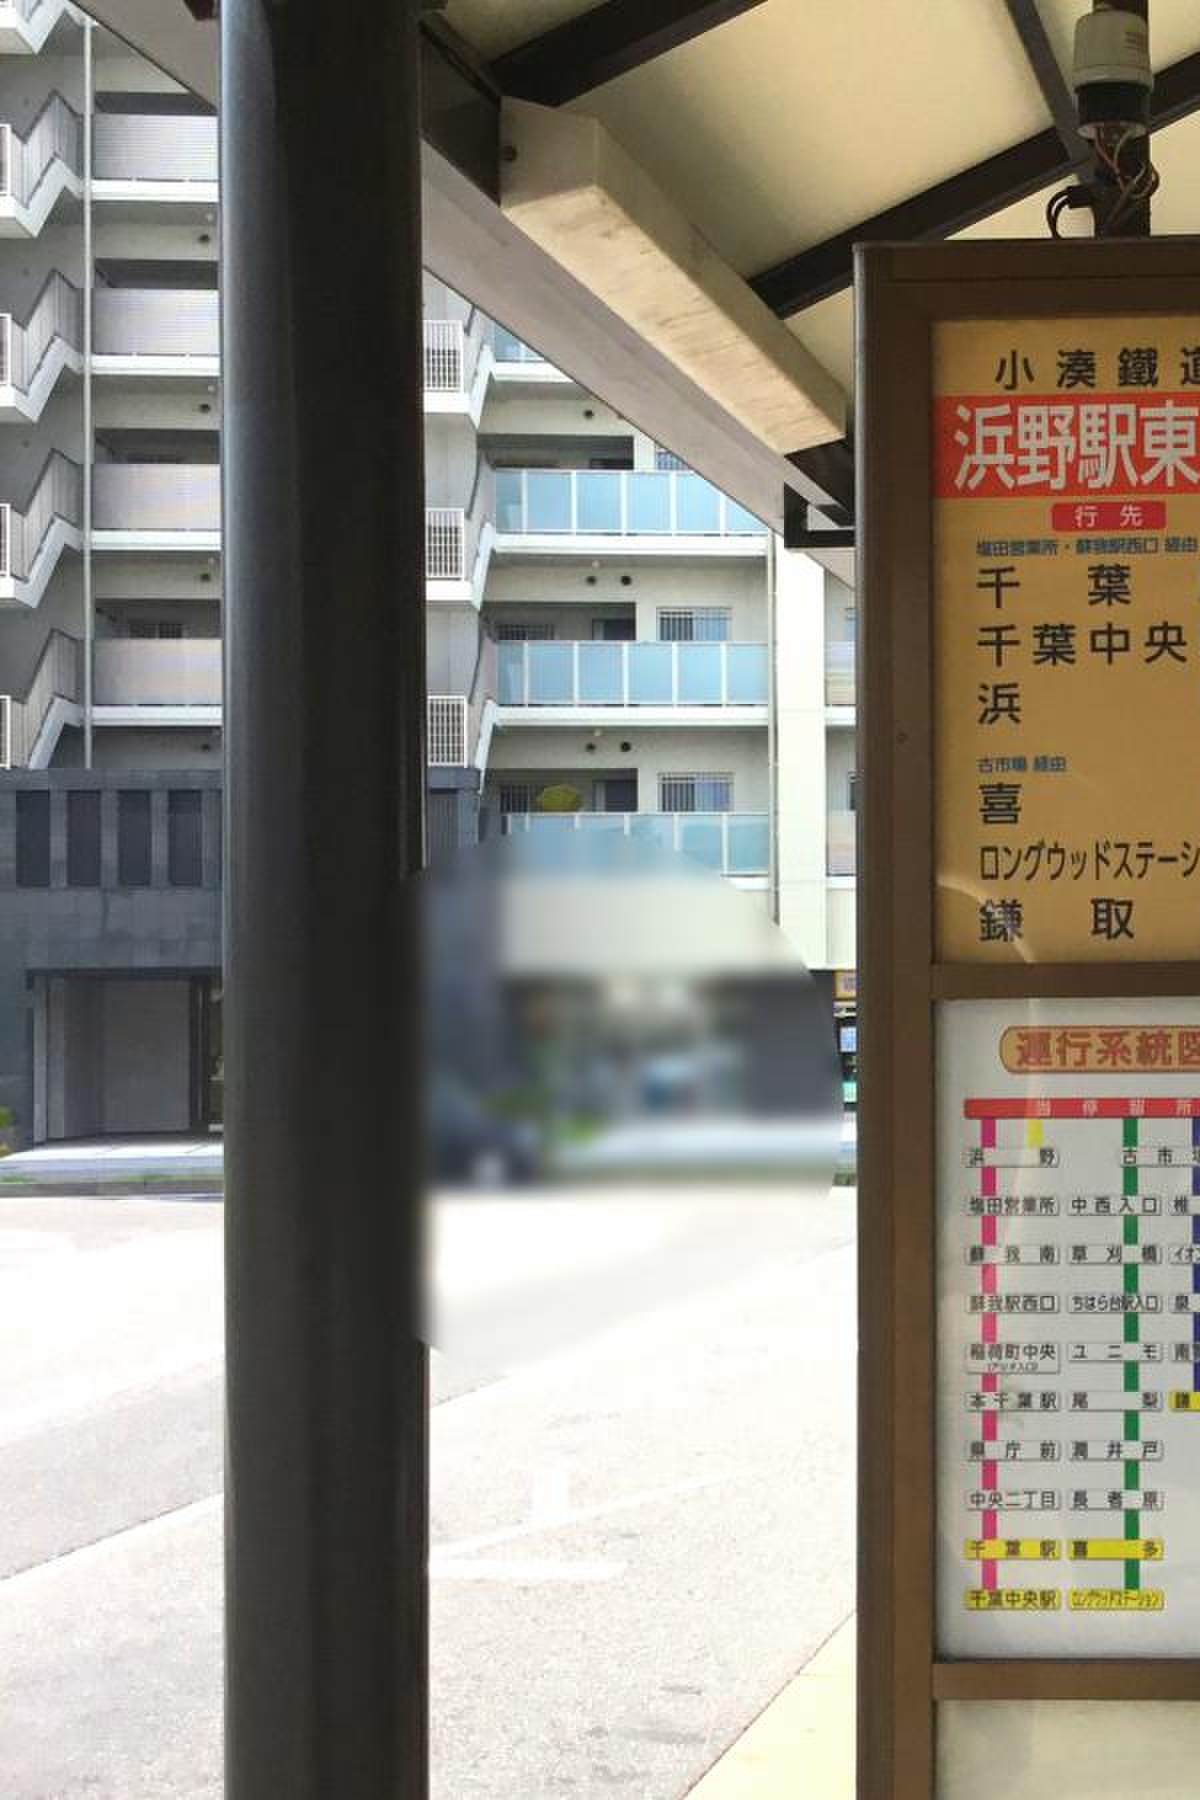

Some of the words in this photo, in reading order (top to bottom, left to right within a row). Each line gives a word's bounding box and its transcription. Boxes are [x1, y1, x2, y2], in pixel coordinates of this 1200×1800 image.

[1073, 505, 1144, 528] 行先
[1071, 1197, 1158, 1214] 中西入口
[1072, 1344, 1159, 1360] ユニモ
[969, 1392, 1057, 1409] 本千葉駅
[969, 1490, 1056, 1509] 中央二丁目
[969, 1590, 1057, 1609] 千葉中央駅
